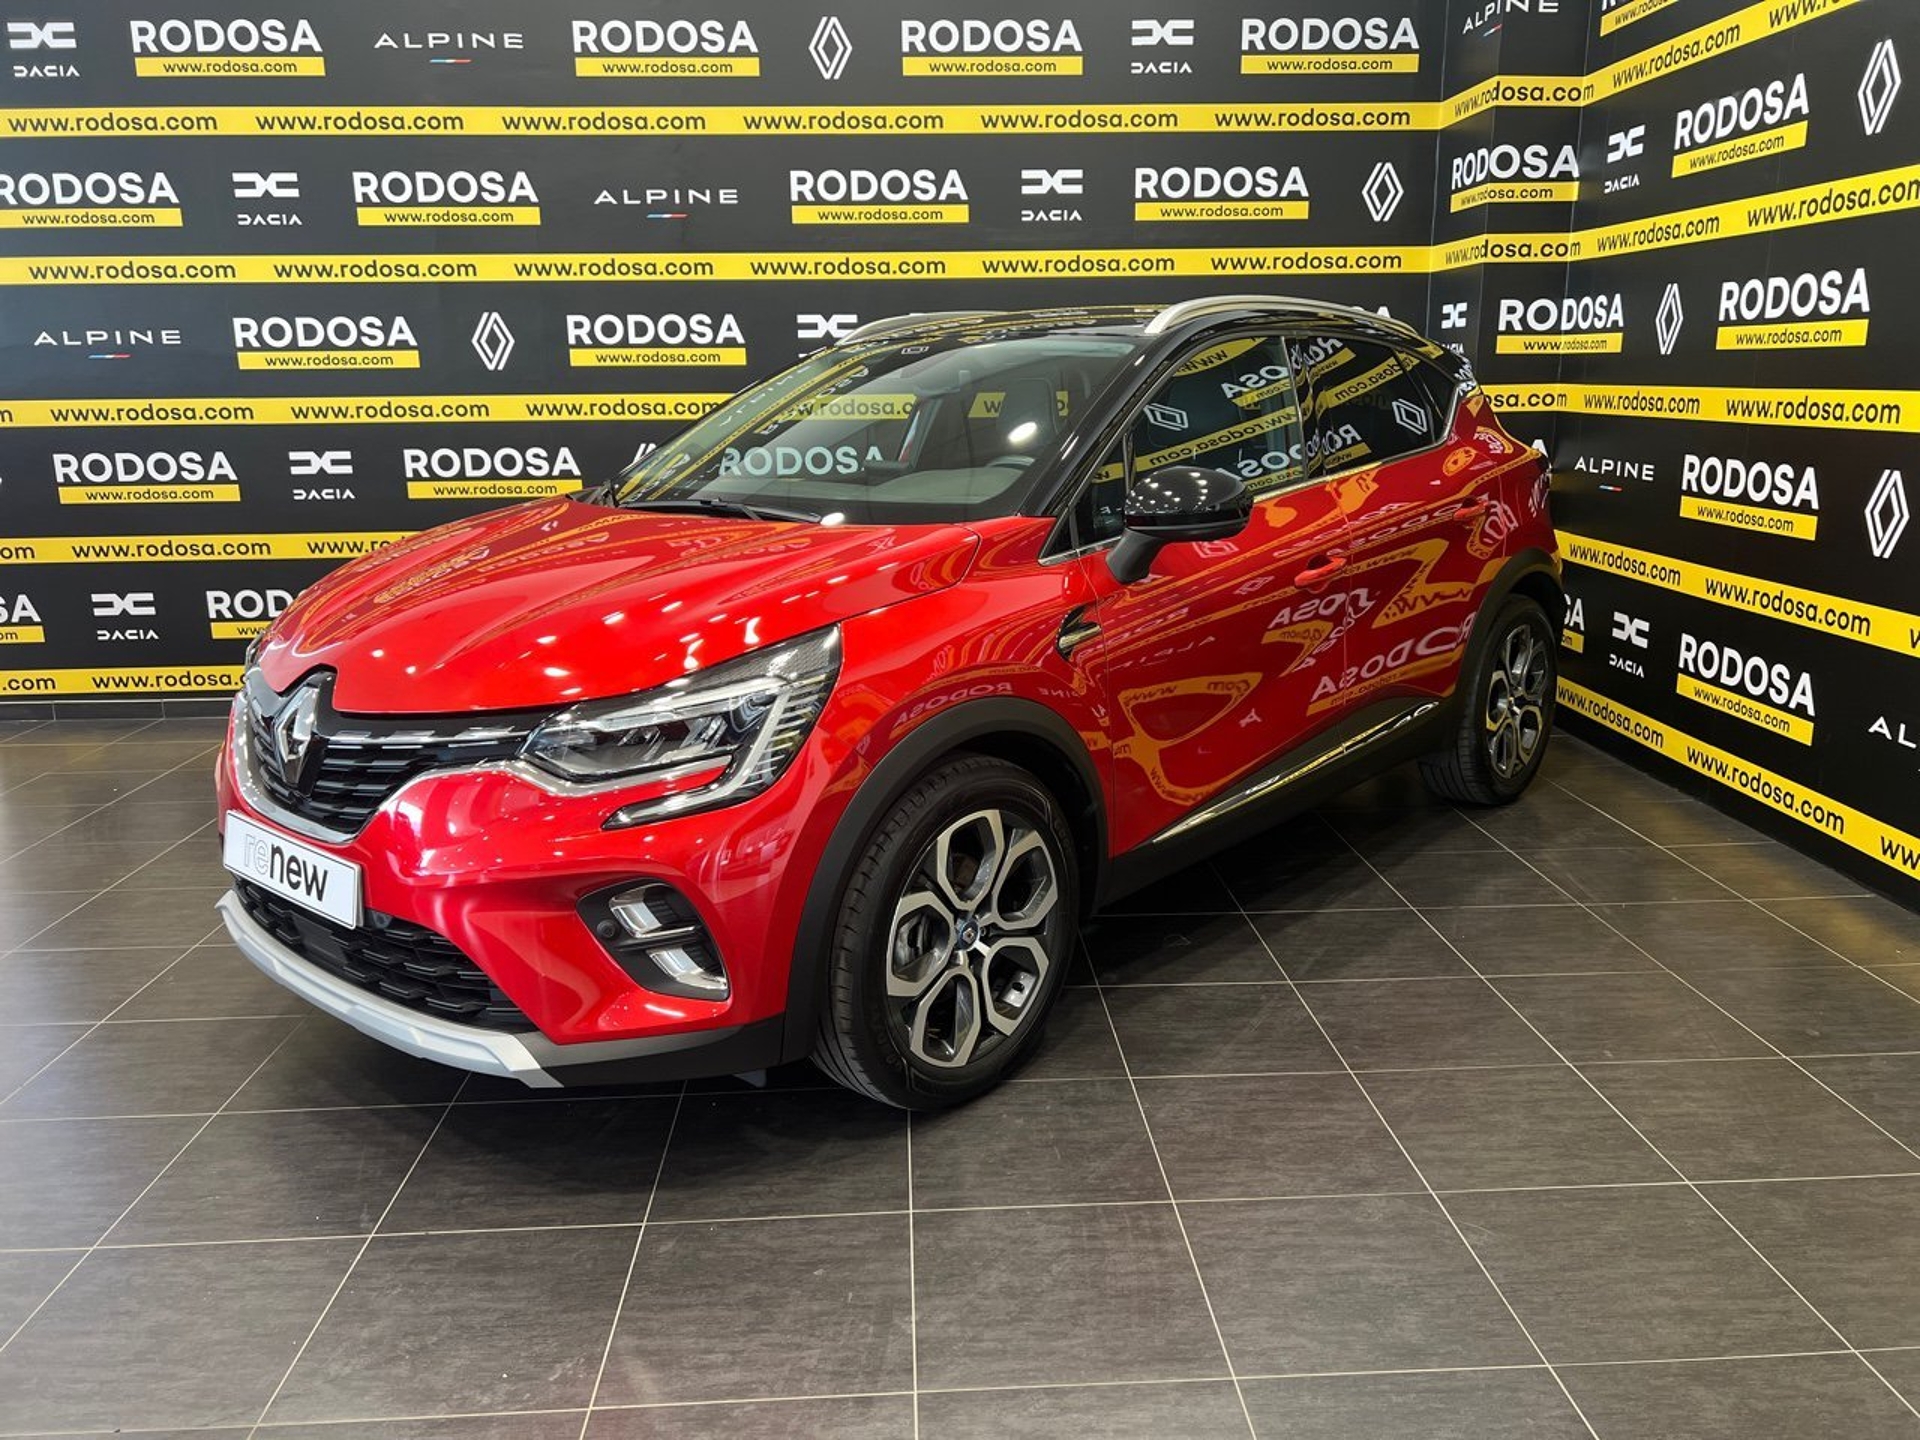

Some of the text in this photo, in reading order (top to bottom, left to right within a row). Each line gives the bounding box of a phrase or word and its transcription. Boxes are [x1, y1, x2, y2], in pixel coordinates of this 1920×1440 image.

[1462, 0, 1559, 34] ALPINE
[130, 19, 322, 52] RODOSA
[375, 33, 523, 48] ALPINE
[572, 20, 758, 53] RODOSA
[902, 20, 1082, 52] RODOSA
[1242, 18, 1419, 50] RODOSA
[14, 66, 79, 77] DACIA
[163, 60, 298, 74] www.rodosa.com
[603, 61, 732, 73] www.rodosa.com
[930, 60, 1056, 72] www.rodosa.com
[1131, 62, 1192, 73] DACIA
[1267, 58, 1392, 72] www.rodosa.com
[8, 23, 1740, 131] www.rodosa.com www.rodosa.com www.rodosa.com www.rodosa.com www.rodosa.com www.rodosa.com www.rodosa.com www.rodosa.com
[1674, 73, 1809, 150] RODOSA
[1689, 134, 1784, 169] www.rodosa.com
[1451, 144, 1579, 190] RODOSA
[353, 171, 538, 203] RODOSA
[790, 170, 968, 201] RODOSA
[1135, 167, 1308, 198] RODOSA
[1605, 175, 1639, 193] DACIA
[594, 190, 738, 204] ALPINE
[1461, 186, 1553, 204] www.rodosa.com
[23, 212, 154, 224] www.rodosa.com
[238, 214, 302, 225] DACIA
[385, 211, 513, 222] www.rodosa.com
[818, 209, 943, 221] www.rodosa.com
[1022, 210, 1081, 221] DACIA
[1160, 205, 1283, 218] www.rodosa.com
[29, 261, 235, 279] www.rodosa.com
[274, 260, 476, 277] www.rodosa.com
[514, 258, 713, 276] www.rodosa.com
[750, 258, 945, 274] www.rodosa.com
[983, 255, 1174, 273] www.rodosa.com
[1211, 252, 1401, 270] www.rodosa.com
[1445, 239, 1580, 264] www.rodosa.com
[1598, 215, 1720, 252] www.rodosa.com
[1719, 267, 1870, 321] RODOSA
[1498, 294, 1624, 331] RODOSA
[34, 330, 180, 345] ALPINE
[233, 317, 417, 347] RODOSA
[567, 314, 745, 344] RODOSA
[1735, 327, 1842, 345] www.rodosa.com
[1524, 340, 1606, 350] www.rodosa.com
[265, 355, 393, 366] www.rodosa.com
[596, 351, 721, 364] www.rodosa.com
[51, 404, 253, 421] www.rodosa.com
[291, 401, 489, 419] www.rodosa.com
[1485, 390, 1900, 424] osa.com www.rodosa.com www.rodosa.com
[53, 451, 238, 483] RODOSA
[404, 447, 581, 478] RODOSA
[1575, 457, 1654, 480] ALPINE
[433, 484, 557, 495] www.rodosa.com
[1681, 454, 1819, 510] RODOSA
[86, 488, 214, 501] www.rodosa.com
[293, 489, 355, 499] DACIA
[1697, 504, 1794, 532] www.rodosa.com
[72, 540, 271, 558] www.rodosa.com
[1570, 543, 1871, 636] www.rodosa.com www.rodosa.com
[206, 590, 293, 618] ROD
[97, 630, 158, 640] DACIA
[1610, 654, 1644, 677] DACIA
[1678, 634, 1815, 716] RODOSA
[1693, 686, 1790, 733] www.rodosa.com
[92, 670, 1844, 834] www.rodosa.c www.rodosa.com www.rodosa.com
[244, 833, 328, 902] renew
